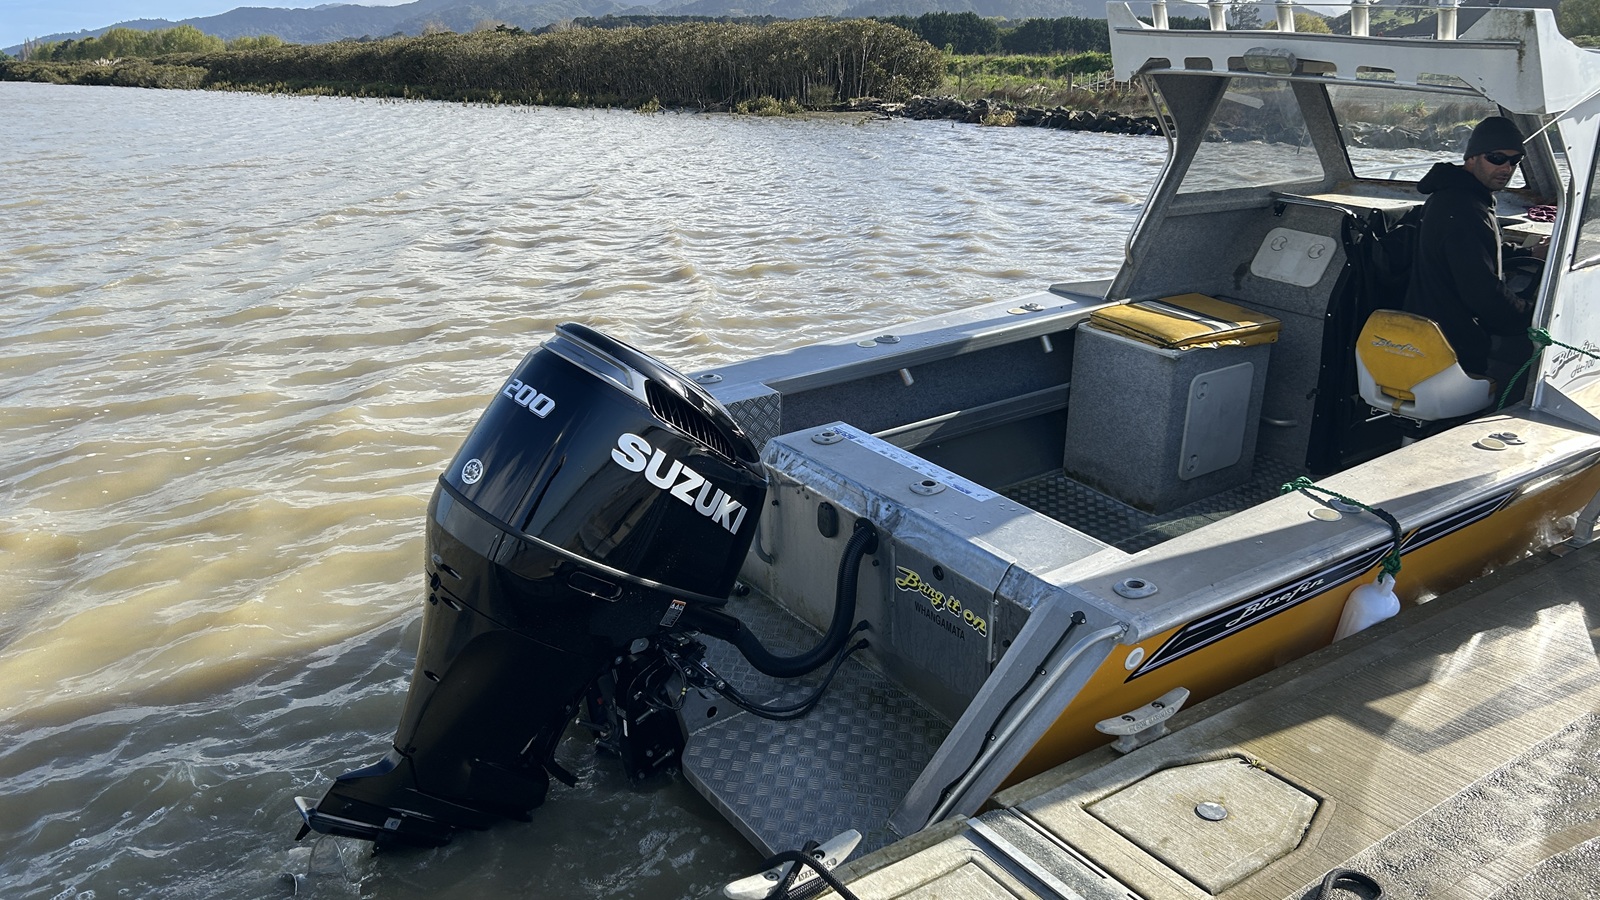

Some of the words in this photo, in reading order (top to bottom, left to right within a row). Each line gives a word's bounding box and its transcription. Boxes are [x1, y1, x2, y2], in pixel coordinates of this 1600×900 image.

[502, 378, 556, 419] 200
[611, 432, 748, 535] SUZUKI
[895, 565, 946, 612] Bring
[946, 595, 962, 618] it
[963, 609, 987, 637] on
[914, 600, 966, 642] WHANGAMATA
[1225, 578, 1324, 628] Bluefin
